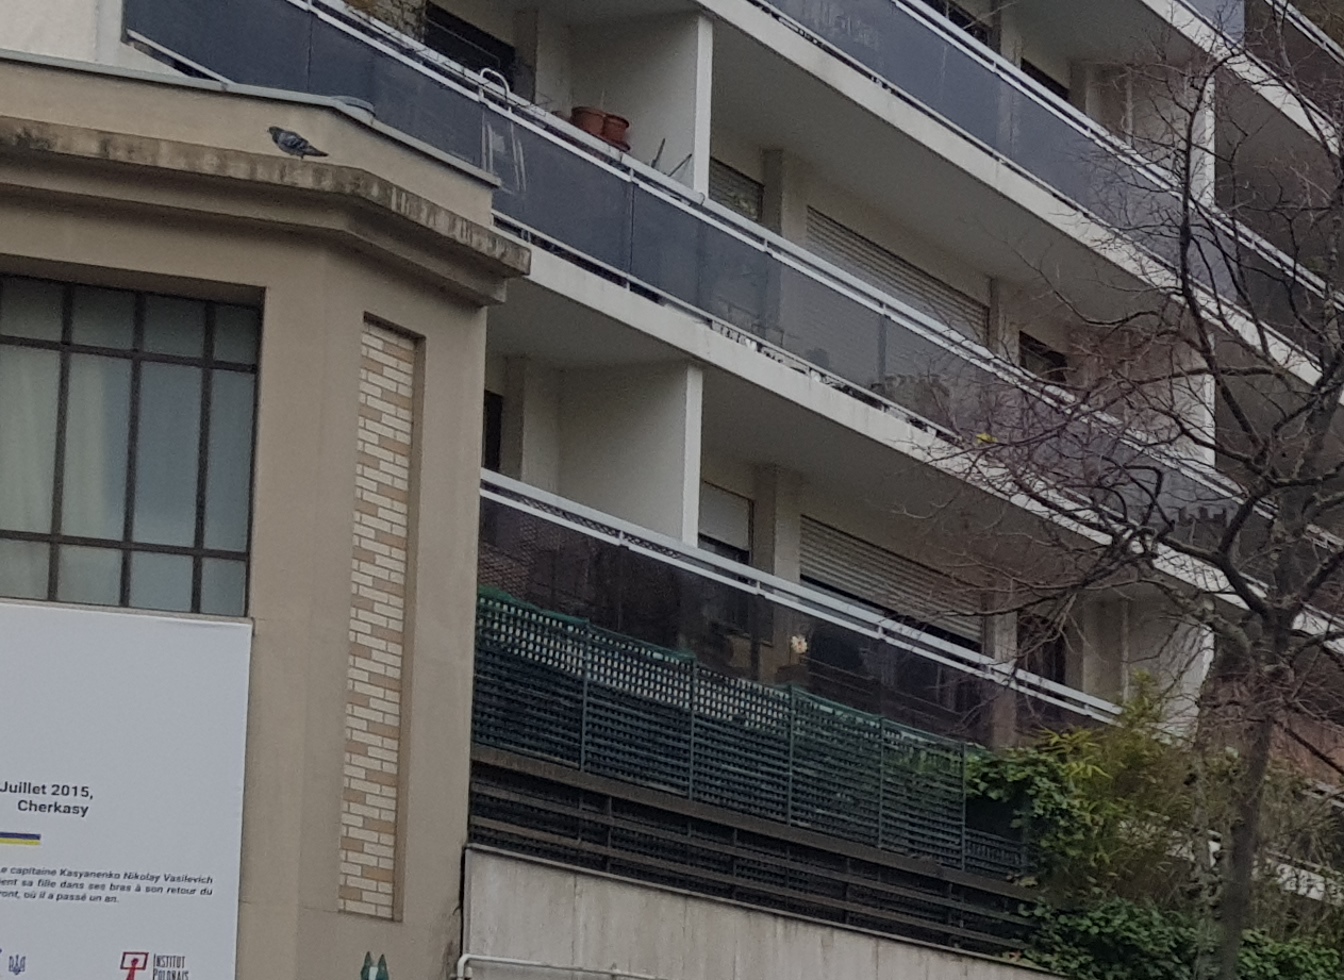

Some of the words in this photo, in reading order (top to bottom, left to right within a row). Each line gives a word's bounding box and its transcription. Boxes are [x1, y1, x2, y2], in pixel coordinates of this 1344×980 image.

[0, 781, 47, 796] Juillet
[51, 784, 94, 800] 2015,
[17, 800, 89, 817] Cherkasy
[10, 867, 57, 876] capitaine
[38, 880, 57, 888] fille
[60, 881, 84, 889] dans
[110, 883, 132, 891] bras
[145, 886, 163, 894] son
[167, 886, 197, 895] retour
[200, 887, 213, 896] du
[0, 890, 20, 899] ront,
[39, 891, 46, 899] il
[56, 893, 87, 902] passé
[153, 953, 185, 968] INSTITUT
